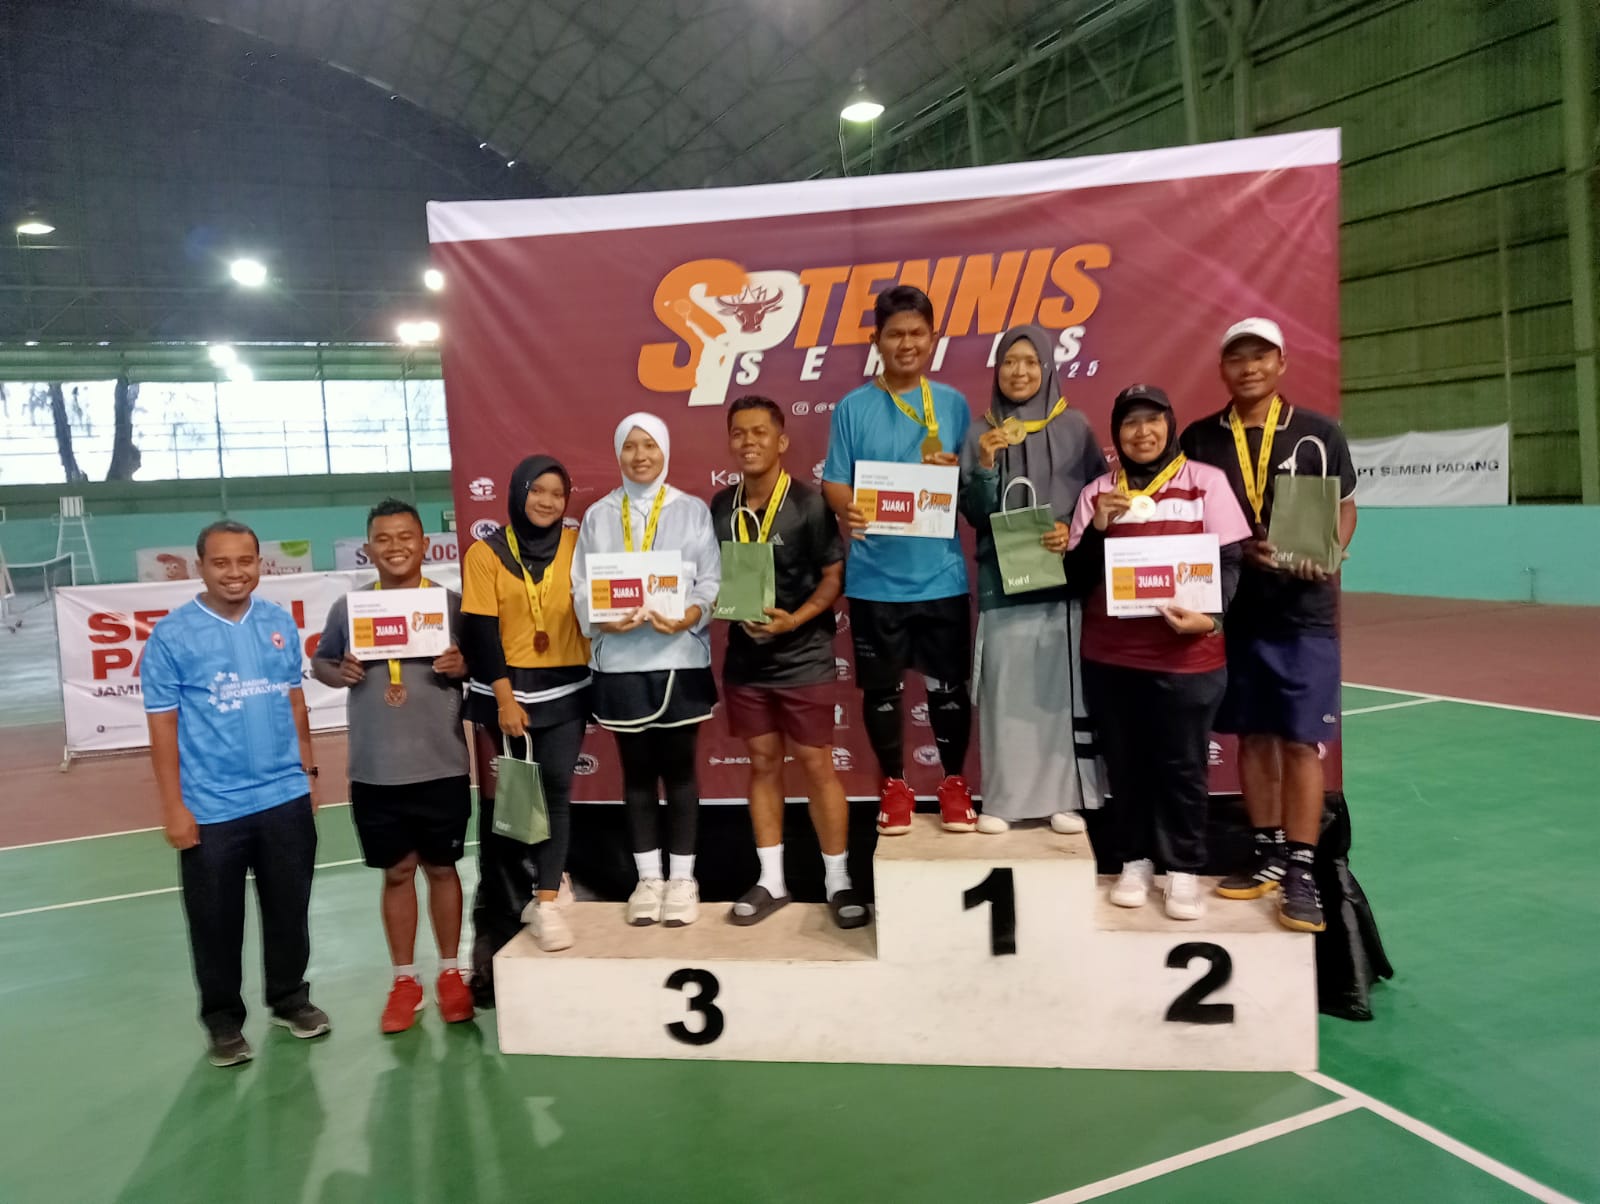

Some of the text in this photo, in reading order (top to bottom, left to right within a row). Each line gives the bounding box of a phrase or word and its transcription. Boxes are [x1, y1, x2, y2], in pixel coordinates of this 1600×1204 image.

[794, 244, 1111, 349] TENNIS
[1357, 459, 1499, 478] PT SEMEN PADANG
[881, 499, 905, 512] JUARA
[906, 501, 911, 513] 1
[1138, 574, 1163, 588] JUARA
[1165, 573, 1170, 587] 2
[613, 587, 634, 599] JUARA
[376, 625, 398, 637] JUARA
[963, 868, 1016, 957] 1
[1164, 942, 1234, 1024] 2
[664, 968, 724, 1046] 3
